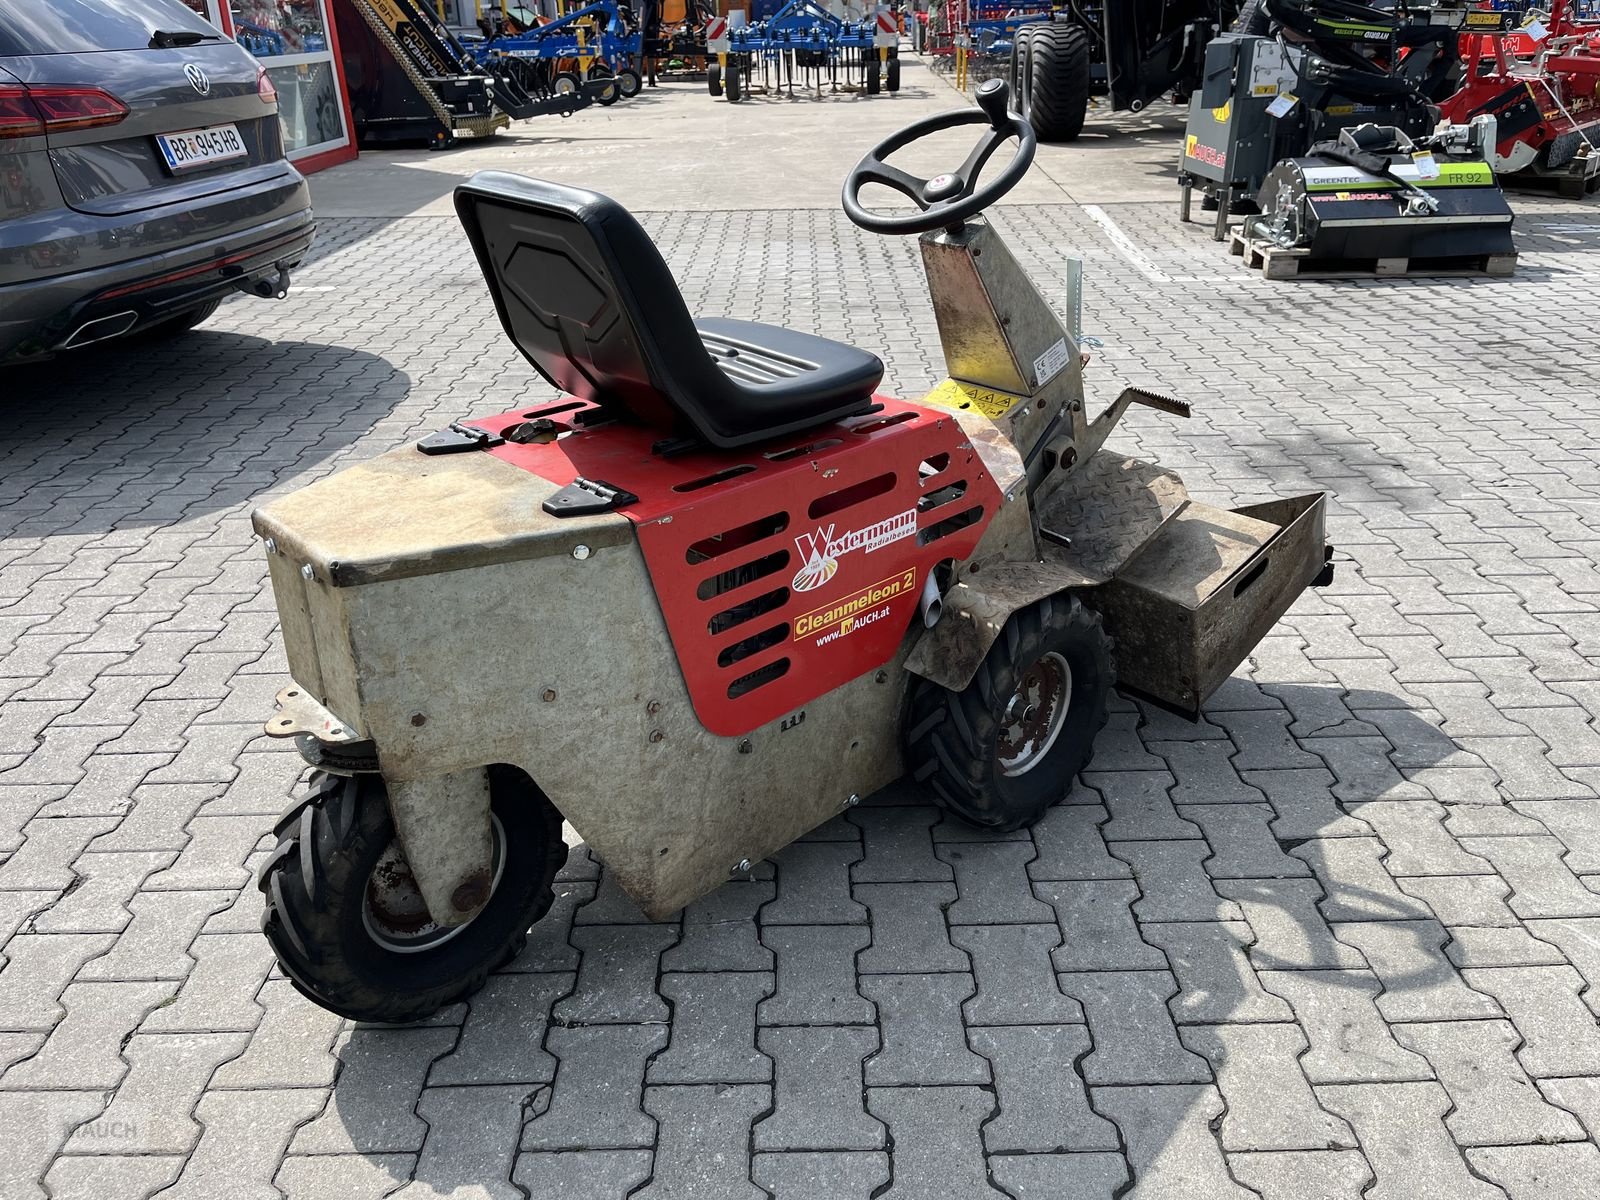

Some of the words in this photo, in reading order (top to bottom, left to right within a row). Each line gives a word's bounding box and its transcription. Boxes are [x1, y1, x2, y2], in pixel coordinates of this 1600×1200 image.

[1363, 30, 1390, 40] HYBRID
[170, 138, 193, 161] BR
[195, 132, 223, 156] 945
[222, 129, 240, 152] HB
[1450, 173, 1463, 183] FR
[1467, 173, 1482, 183] 92
[795, 511, 915, 568] Westermann
[867, 526, 915, 550] Radialbesen
[795, 581, 900, 636] Cleanmeleon
[903, 571, 914, 587] 2
[816, 606, 891, 647] www.MAUCH.at
